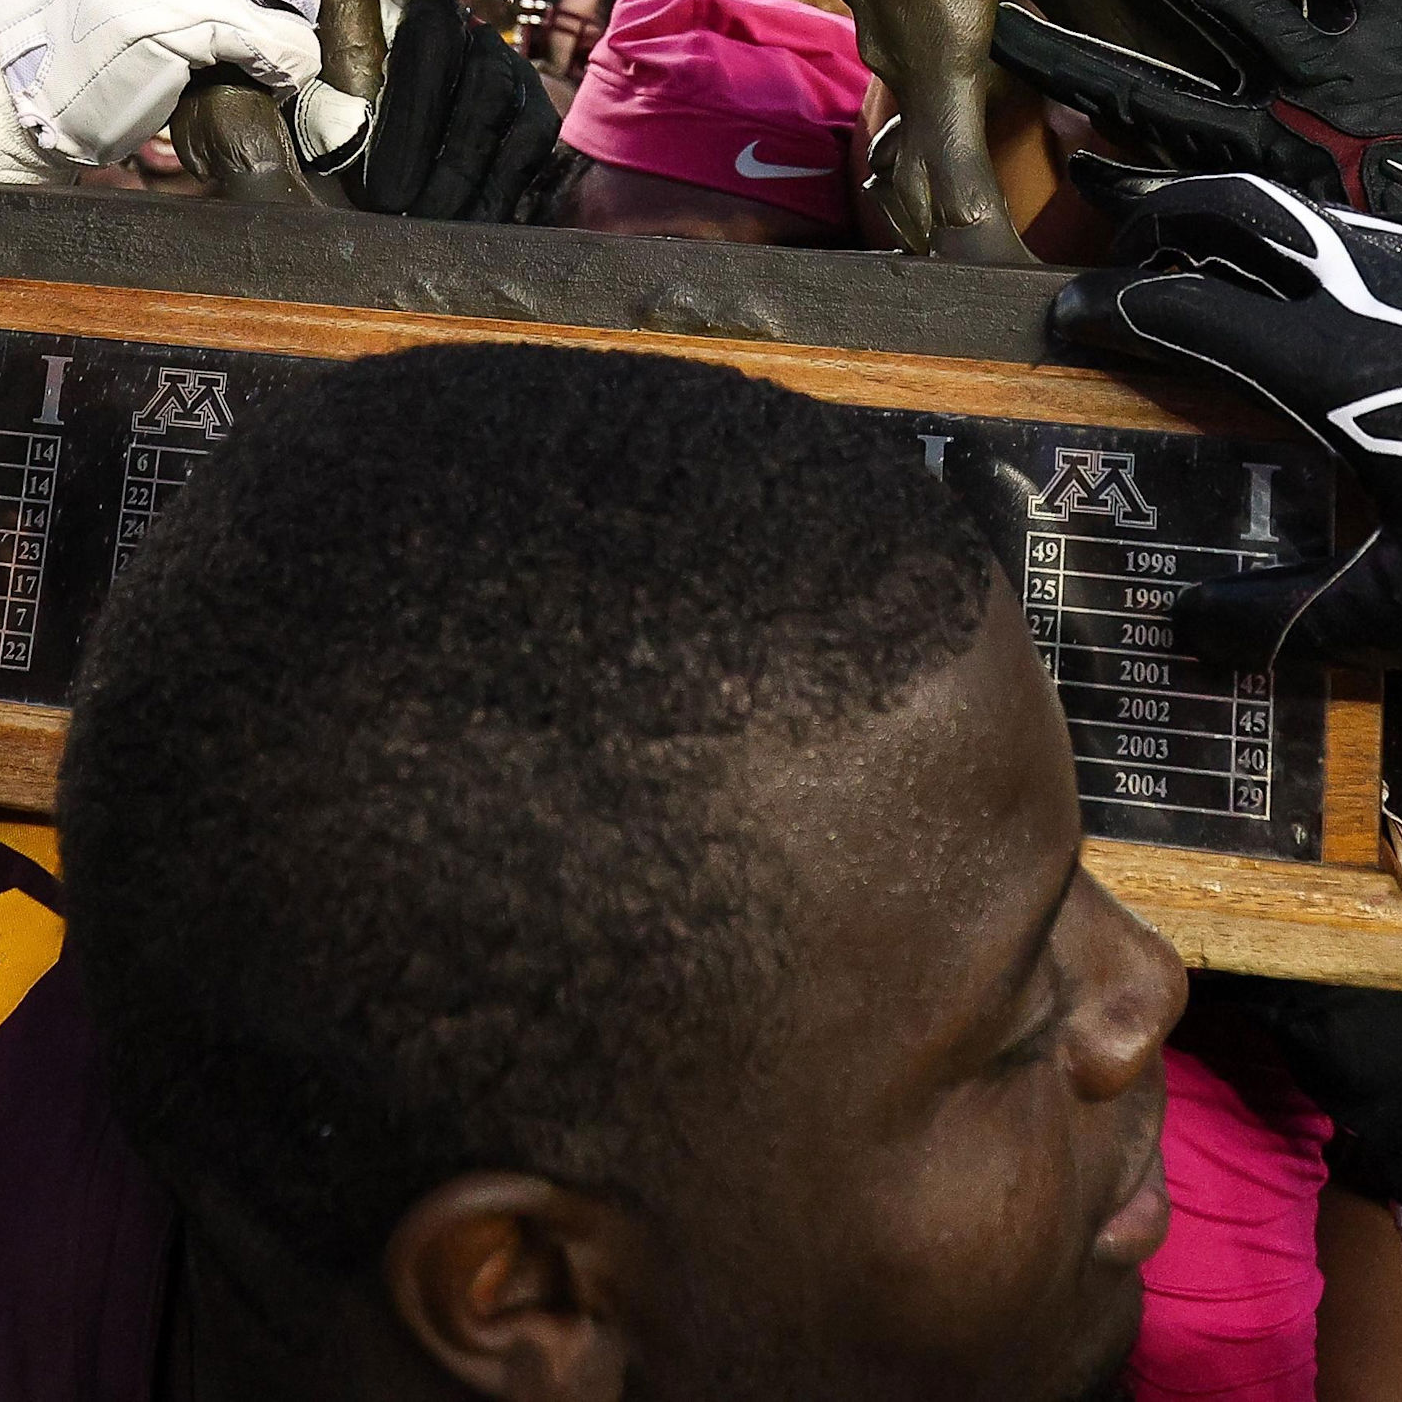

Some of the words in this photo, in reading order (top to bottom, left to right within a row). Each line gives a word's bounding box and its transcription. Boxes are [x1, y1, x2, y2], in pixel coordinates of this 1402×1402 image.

[34, 442, 55, 463] 14
[136, 452, 150, 473] 6
[29, 476, 50, 496] 14
[127, 486, 150, 507] 22
[1026, 446, 1158, 530] M
[24, 508, 46, 529] 14
[122, 519, 146, 540] 24
[18, 540, 41, 561] 23
[1030, 540, 1060, 564] 49
[1125, 550, 1178, 576] 1998
[14, 573, 38, 594] 17
[1030, 577, 1058, 601] 25
[1123, 587, 1176, 611] 1999
[15, 607, 28, 627] 7
[1029, 613, 1056, 637] 27
[1121, 623, 1175, 648] 2000
[3, 640, 27, 662] 22
[1119, 659, 1172, 687] 2001
[1239, 673, 1267, 695] 42
[1117, 697, 1172, 723] 2002
[1238, 710, 1267, 734] 45
[1115, 734, 1170, 761] 2003
[1237, 747, 1266, 772] 40
[1114, 771, 1169, 798] 2004
[1236, 785, 1264, 808] 29
